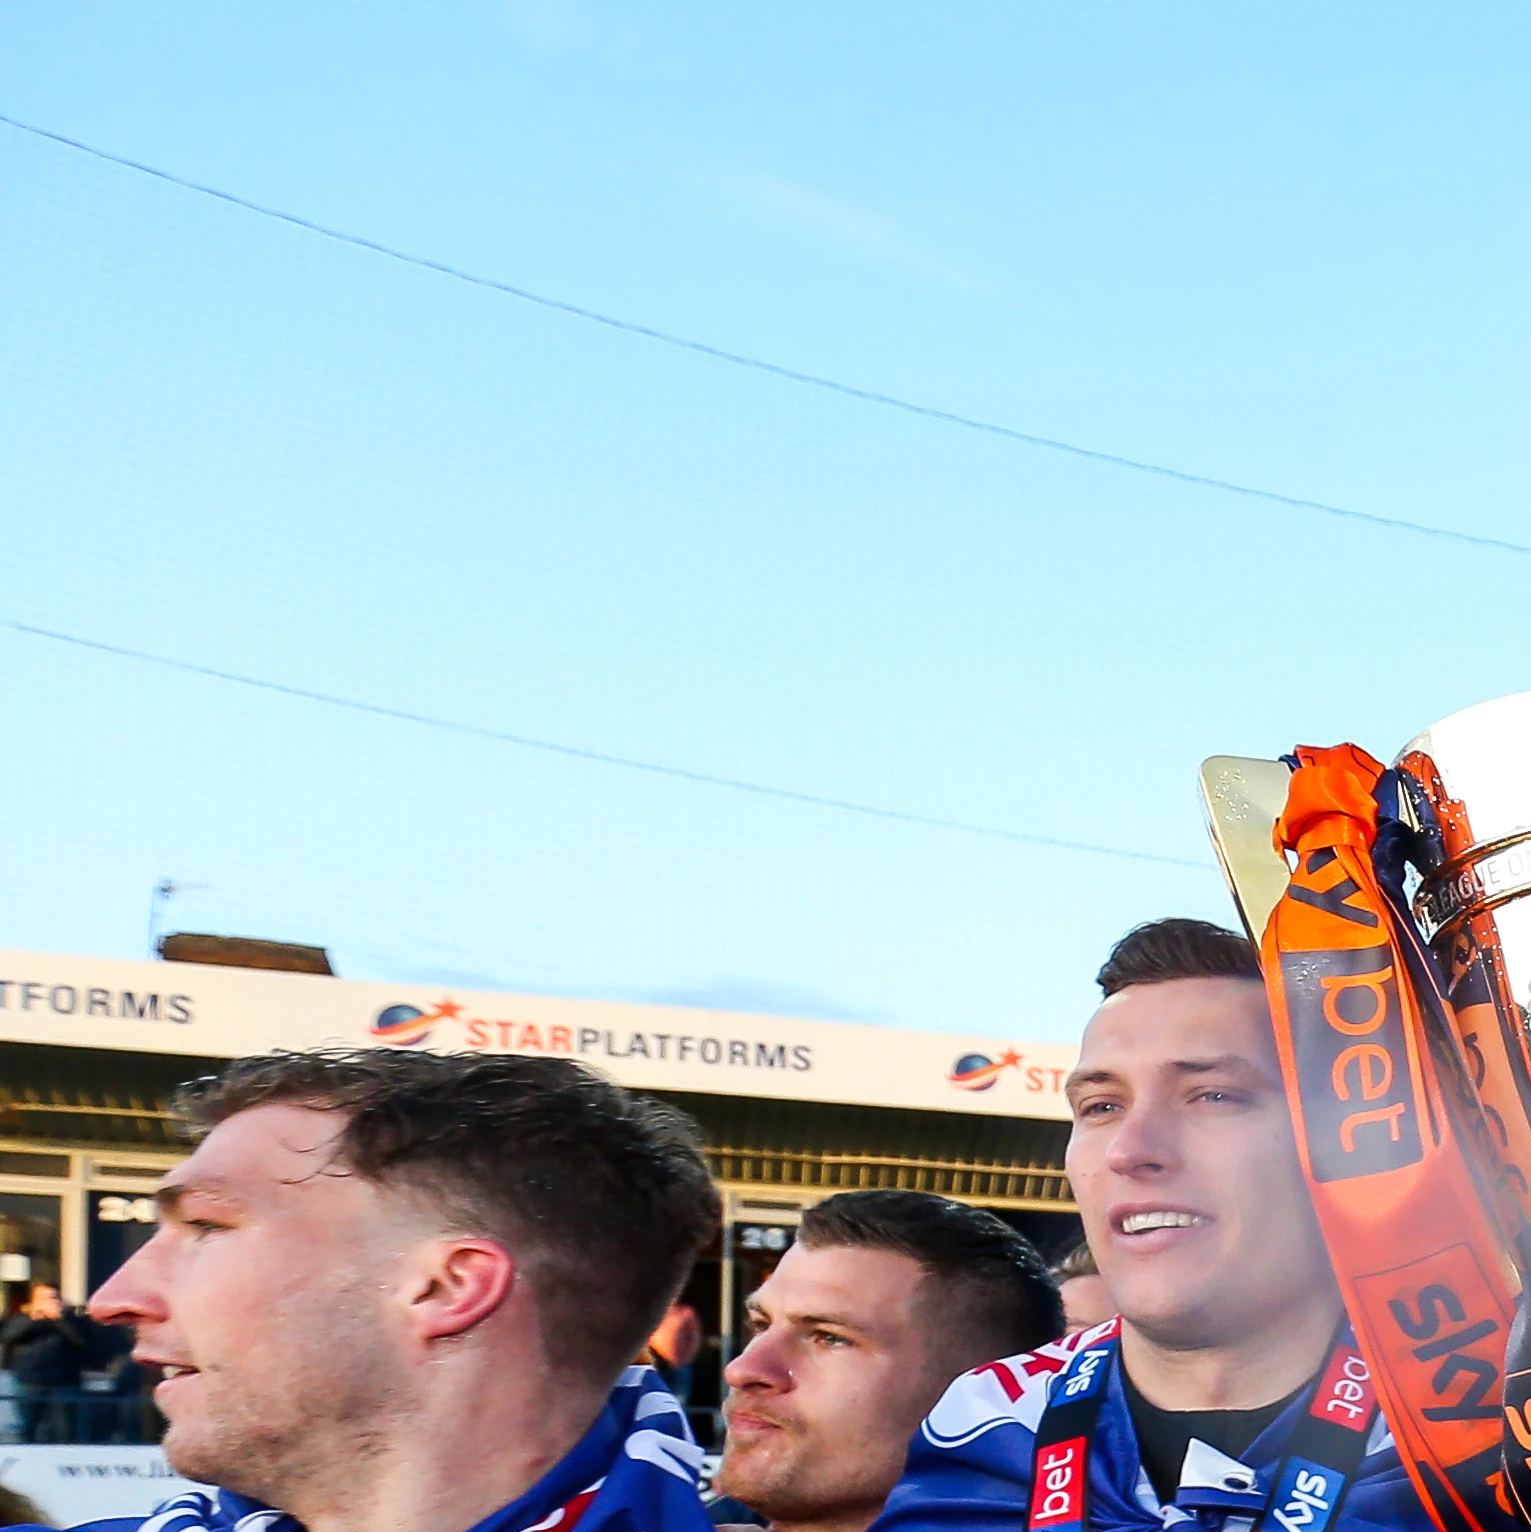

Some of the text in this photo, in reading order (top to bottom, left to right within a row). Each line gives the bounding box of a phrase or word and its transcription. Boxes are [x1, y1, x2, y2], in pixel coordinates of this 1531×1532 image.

[465, 1016, 815, 1073] STARPLATFORMS
[1319, 965, 1407, 1154] bet
[1326, 1354, 1371, 1420] bet
[1034, 1447, 1074, 1520] bet
